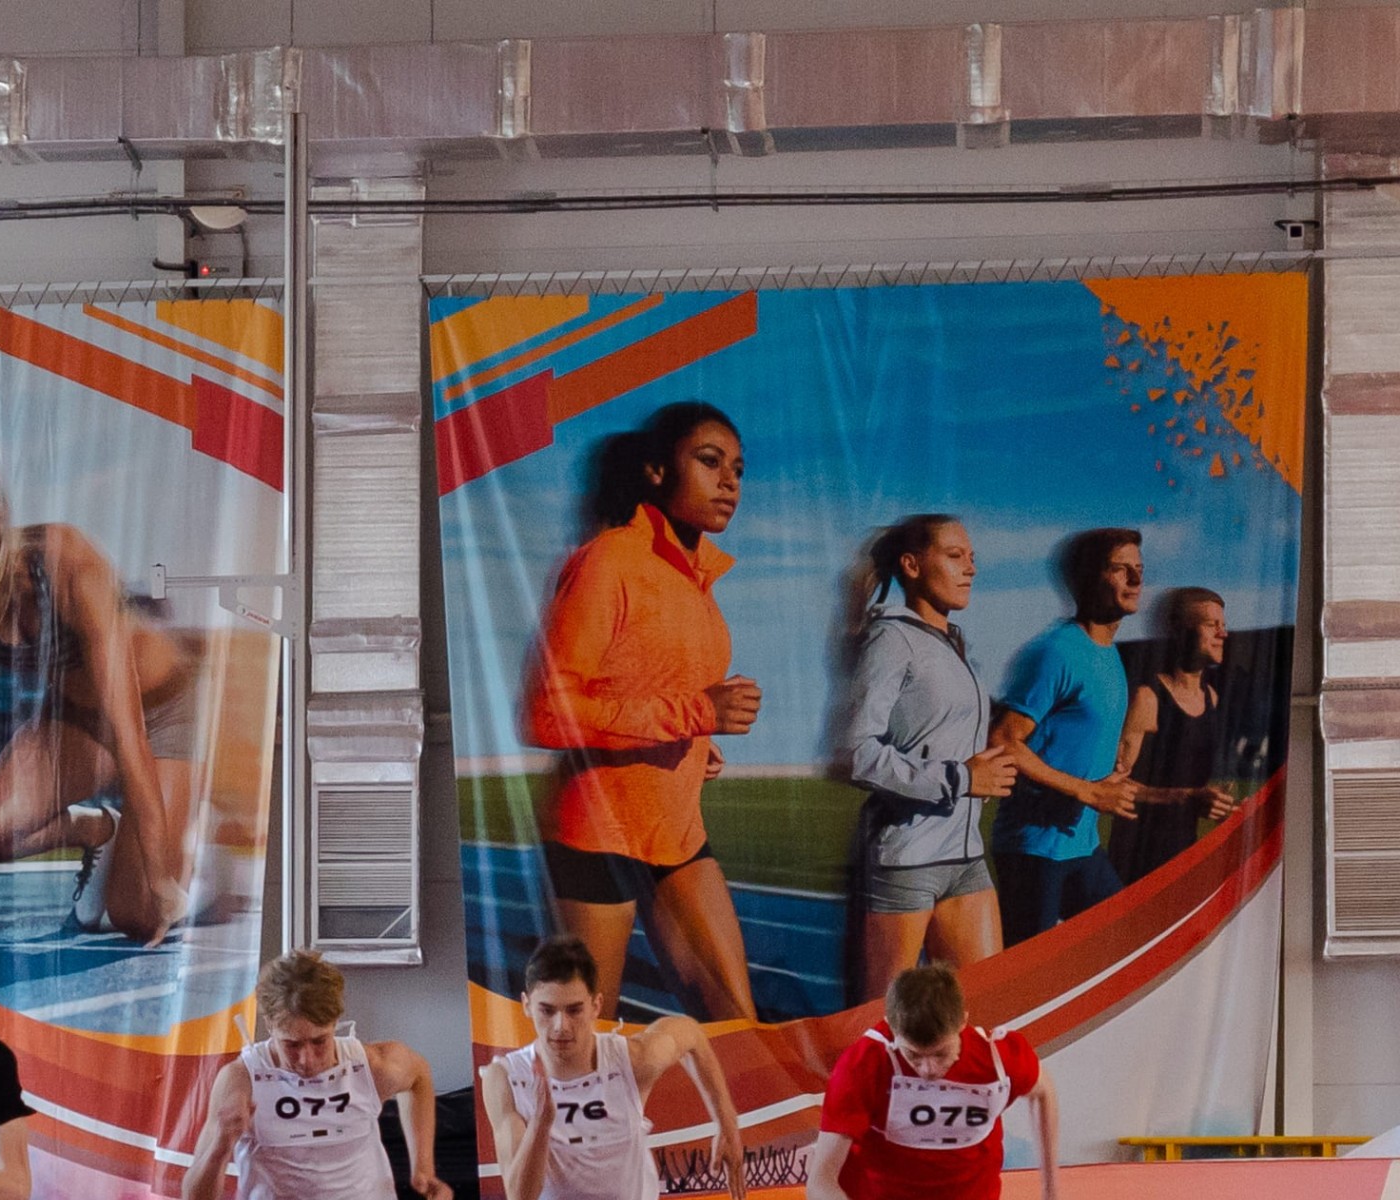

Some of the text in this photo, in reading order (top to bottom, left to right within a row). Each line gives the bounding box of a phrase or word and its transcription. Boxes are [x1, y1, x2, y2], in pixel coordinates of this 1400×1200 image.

[275, 1092, 351, 1120] 077
[556, 1100, 608, 1124] 76
[909, 1104, 989, 1127] 075
